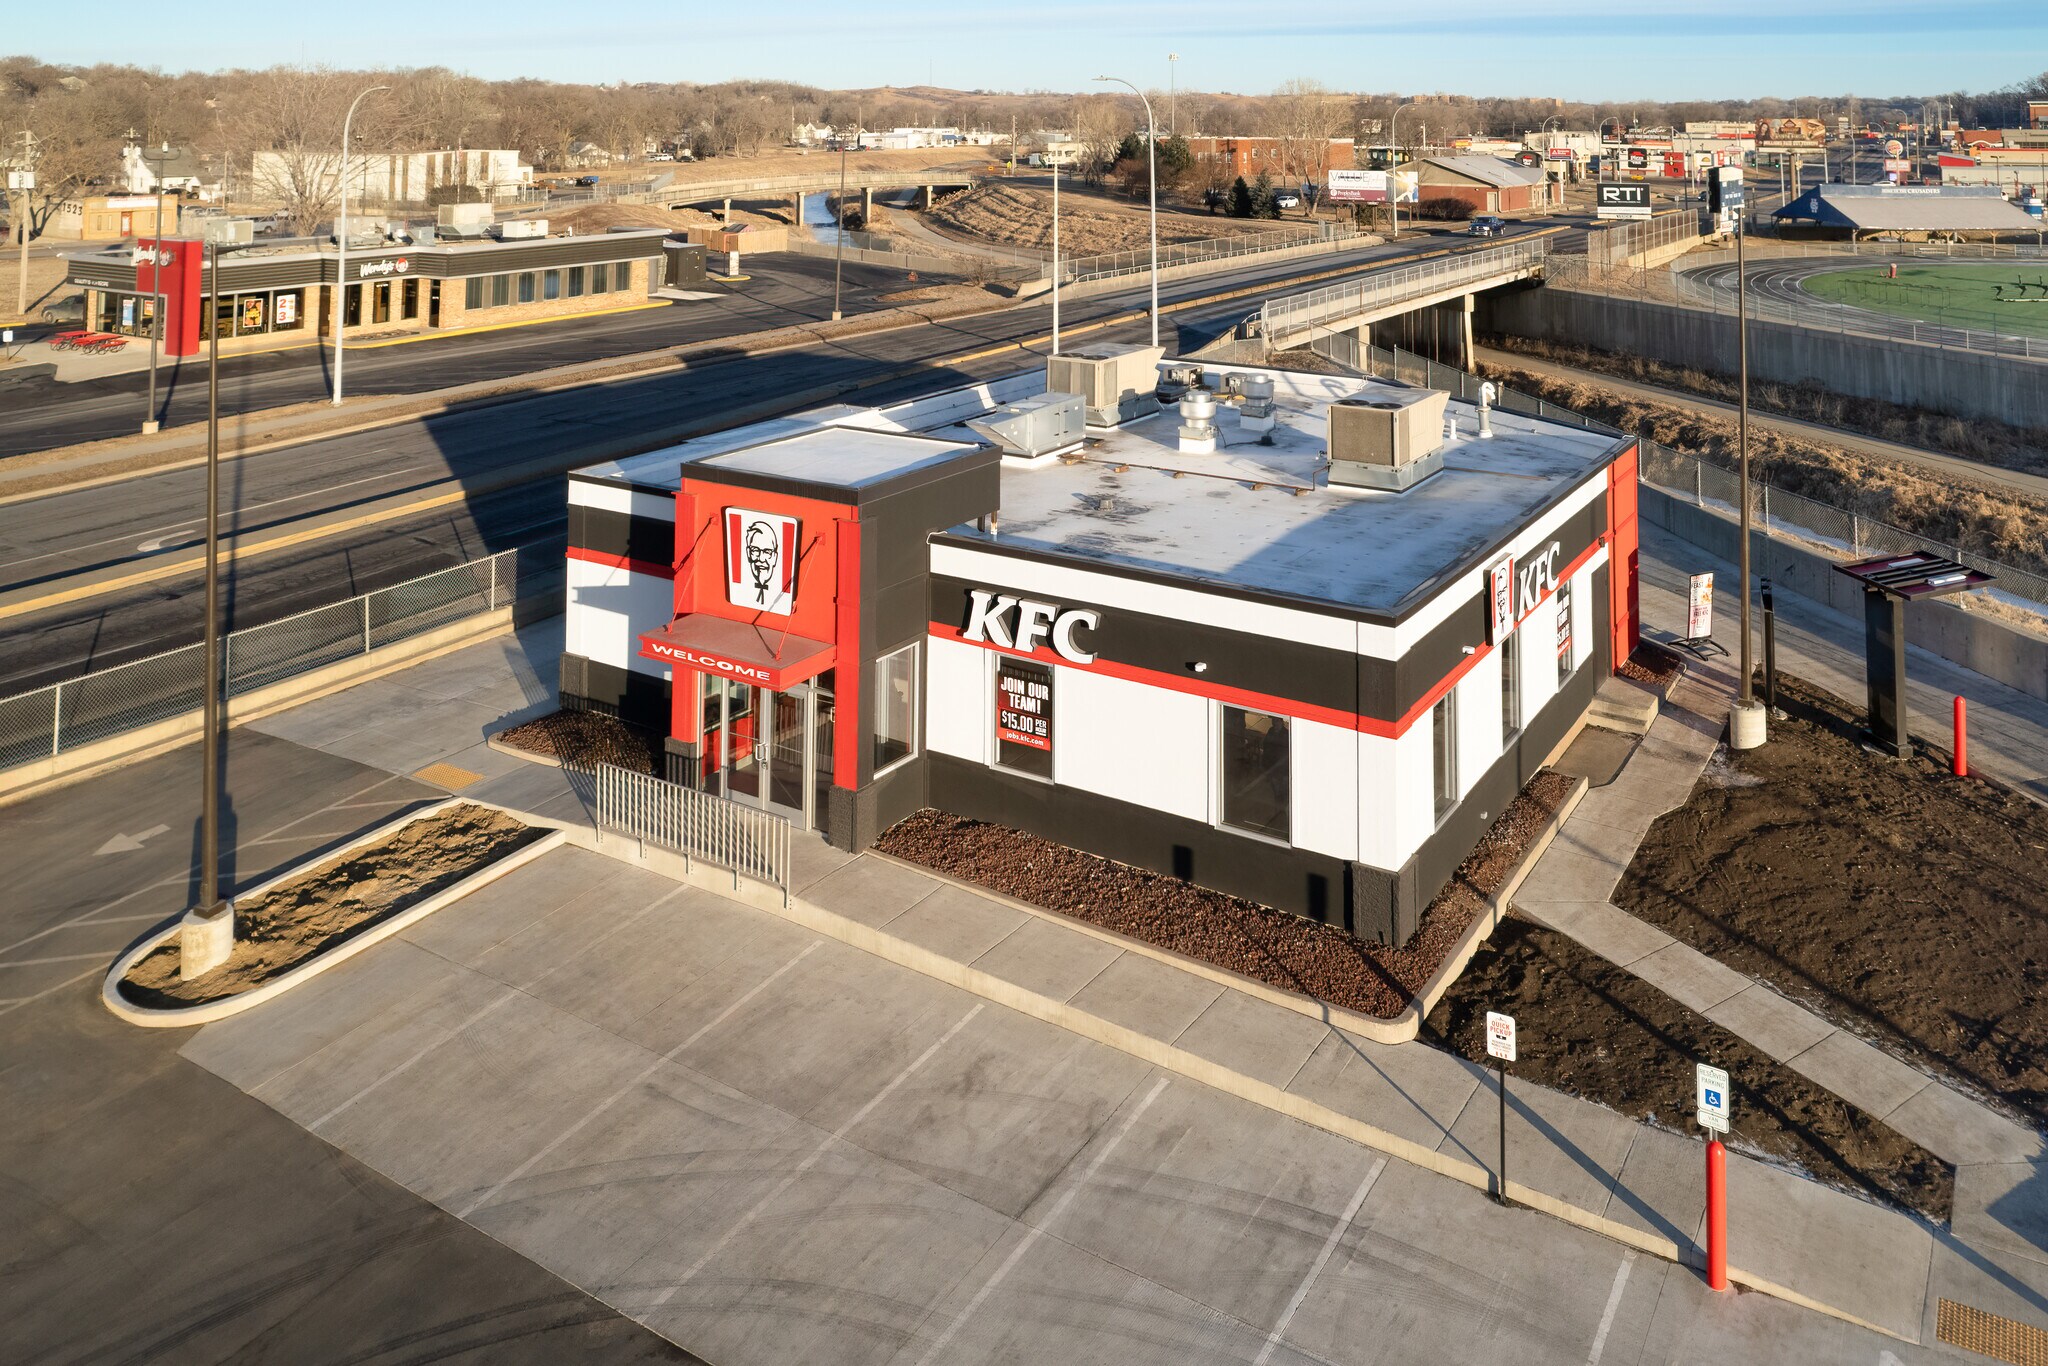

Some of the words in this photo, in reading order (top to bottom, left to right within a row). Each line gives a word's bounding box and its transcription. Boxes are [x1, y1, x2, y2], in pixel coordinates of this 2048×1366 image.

[1330, 171, 1369, 183] VALUE
[1603, 187, 1641, 201] RTI
[62, 202, 83, 216] 1523
[360, 259, 394, 278] Wendy's
[1517, 541, 1561, 623] KFC
[963, 590, 1098, 664] KFC
[651, 643, 771, 681] WELCOME
[1000, 676, 1025, 695] JOIN
[1028, 682, 1049, 701] OUR
[1008, 692, 1041, 715] TEAM!
[1001, 709, 1033, 733] $15.00
[1035, 718, 1047, 728] PER
[1006, 730, 1044, 746] jobs.kfc.com
[1489, 1025, 1512, 1036] PICKUP
[1491, 1020, 1510, 1030] QUICK
[1699, 1068, 1726, 1082] RESERVED
[1701, 1076, 1725, 1089] PARKING
